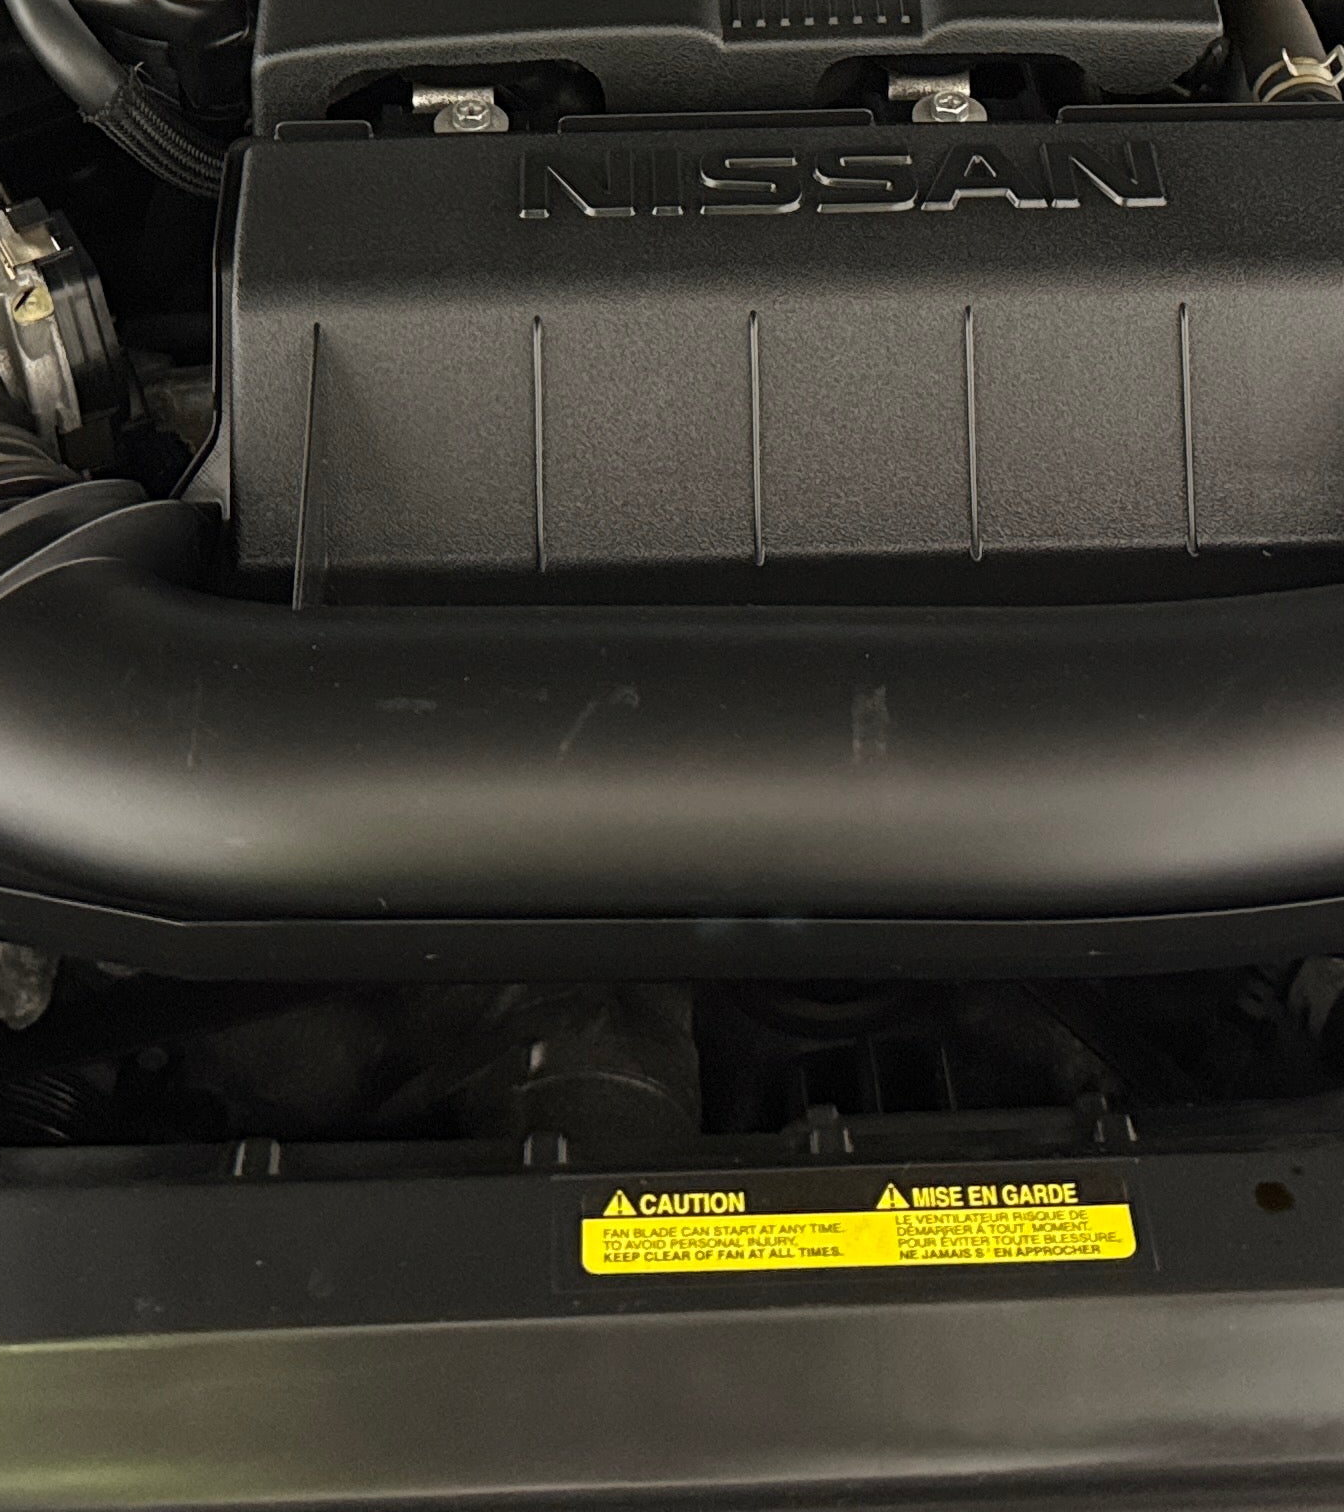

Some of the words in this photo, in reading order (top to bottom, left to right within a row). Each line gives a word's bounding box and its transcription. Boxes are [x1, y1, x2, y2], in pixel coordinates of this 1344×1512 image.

[519, 143, 1168, 218] NISSAN
[912, 1185, 964, 1208] MISE
[967, 1184, 999, 1206] EN
[1001, 1182, 1079, 1205] GARDE
[639, 1192, 746, 1216] CAUTION
[895, 1214, 913, 1225] LE
[915, 1212, 1010, 1225] VENTILATEUR
[1012, 1210, 1066, 1222] RISQUE
[1068, 1209, 1089, 1221] DE
[602, 1228, 630, 1239] FAN
[633, 1227, 677, 1238] BLADE
[681, 1226, 710, 1237] CAN
[713, 1225, 757, 1236] START
[760, 1224, 777, 1235] AT
[778, 1223, 806, 1234] ANY
[987, 1222, 1025, 1235] TOUT
[602, 1240, 623, 1251] TO
[625, 1239, 667, 1250] AVOID
[670, 1237, 744, 1249] PERSONAL
[897, 1237, 937, 1249] POUR
[991, 1233, 1041, 1246] TOUTE
[603, 1252, 641, 1263] KEEP
[643, 1250, 691, 1262] CLEAR
[695, 1250, 713, 1261] OF
[717, 1249, 745, 1260] FAN
[748, 1248, 765, 1259] AT
[768, 1247, 796, 1259] ALL
[899, 1249, 920, 1260] NE
[921, 1247, 973, 1260] JAMAIS
[1015, 1244, 1101, 1257] APPROCHER
